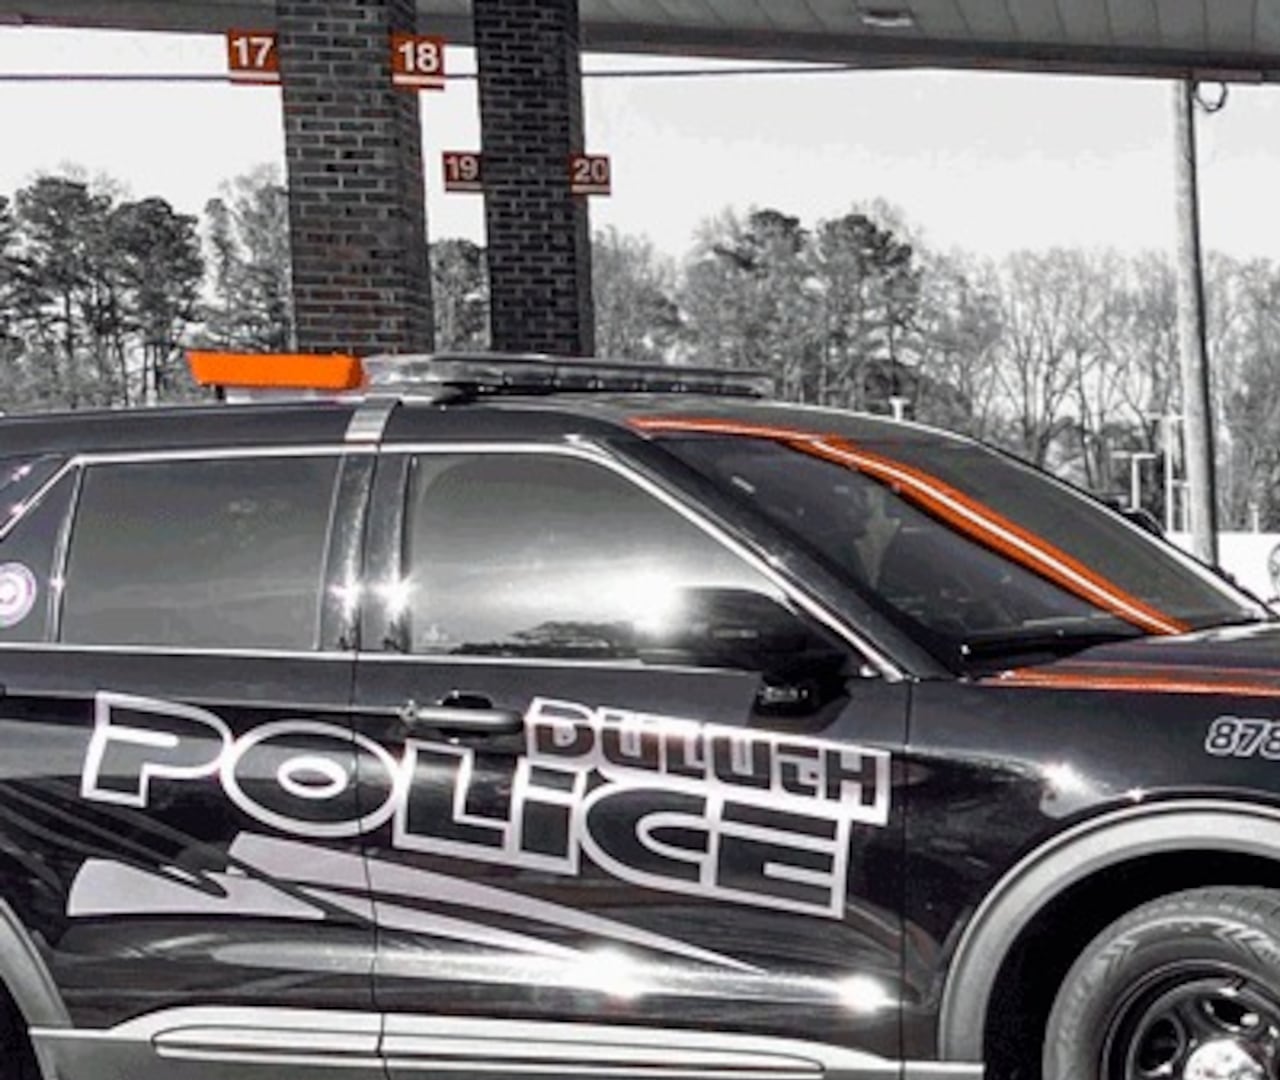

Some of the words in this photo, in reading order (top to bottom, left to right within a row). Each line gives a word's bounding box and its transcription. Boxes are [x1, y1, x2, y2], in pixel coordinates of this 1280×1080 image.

[232, 36, 273, 68] 17
[399, 41, 441, 72] 18
[446, 155, 480, 181] 19
[573, 159, 609, 184] 20
[81, 691, 853, 919] POLICE
